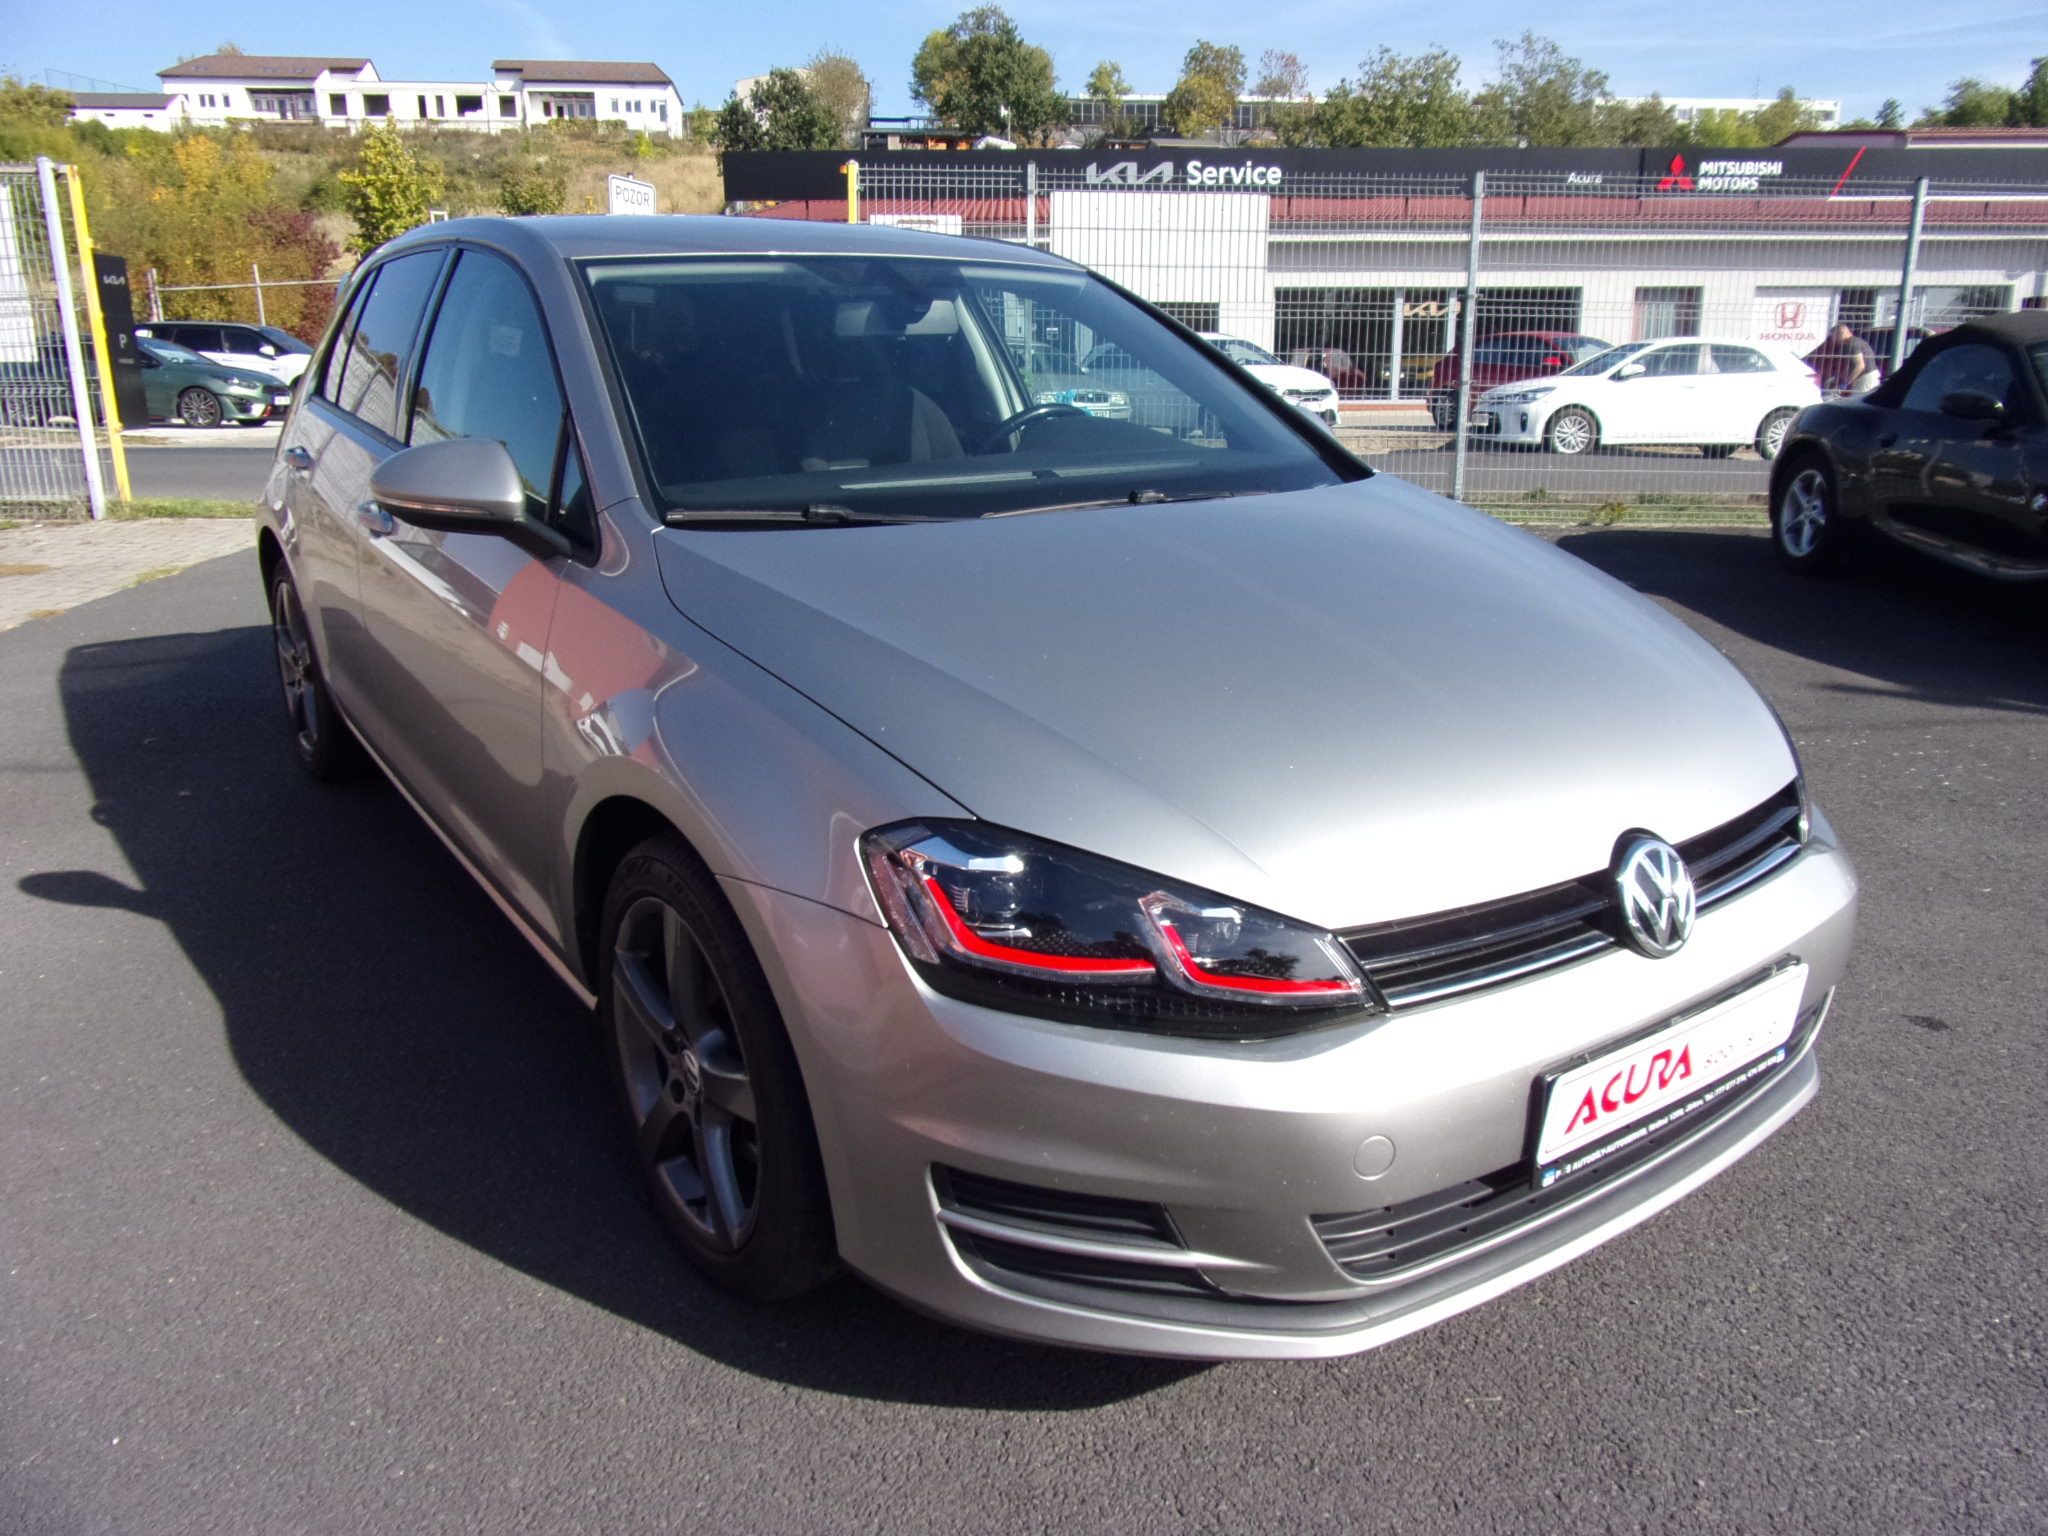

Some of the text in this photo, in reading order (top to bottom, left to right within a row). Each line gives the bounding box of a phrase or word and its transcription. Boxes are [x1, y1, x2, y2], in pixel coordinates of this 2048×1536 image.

[1186, 160, 1282, 185] Service
[1699, 161, 1783, 176] MITSUBISHI
[1567, 172, 1603, 185] Acura
[1697, 177, 1759, 191] MOTORS
[615, 185, 650, 208] POZOR
[1760, 332, 1816, 341] HONDA
[1564, 1043, 1693, 1136] ACURA
